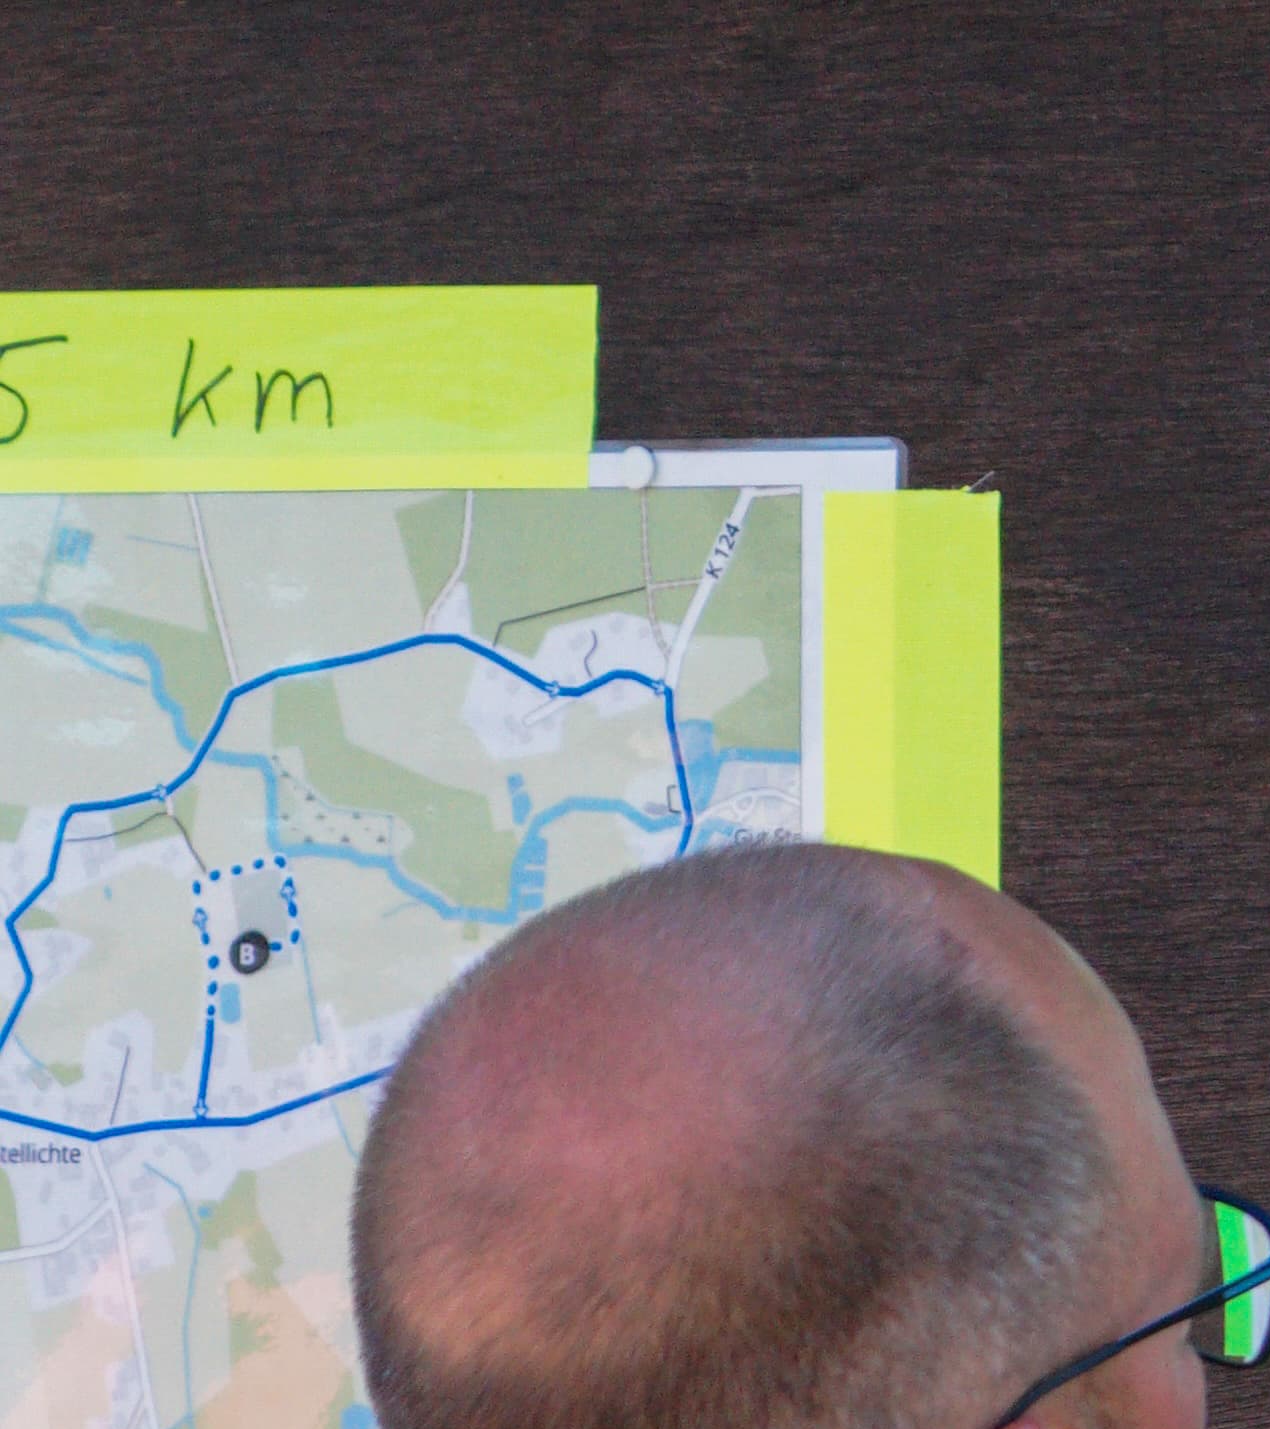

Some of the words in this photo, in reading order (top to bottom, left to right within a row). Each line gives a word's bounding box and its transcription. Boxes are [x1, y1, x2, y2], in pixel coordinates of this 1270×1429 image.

[171, 337, 334, 438] km
[714, 522, 740, 558] 124
[705, 559, 724, 580] K
